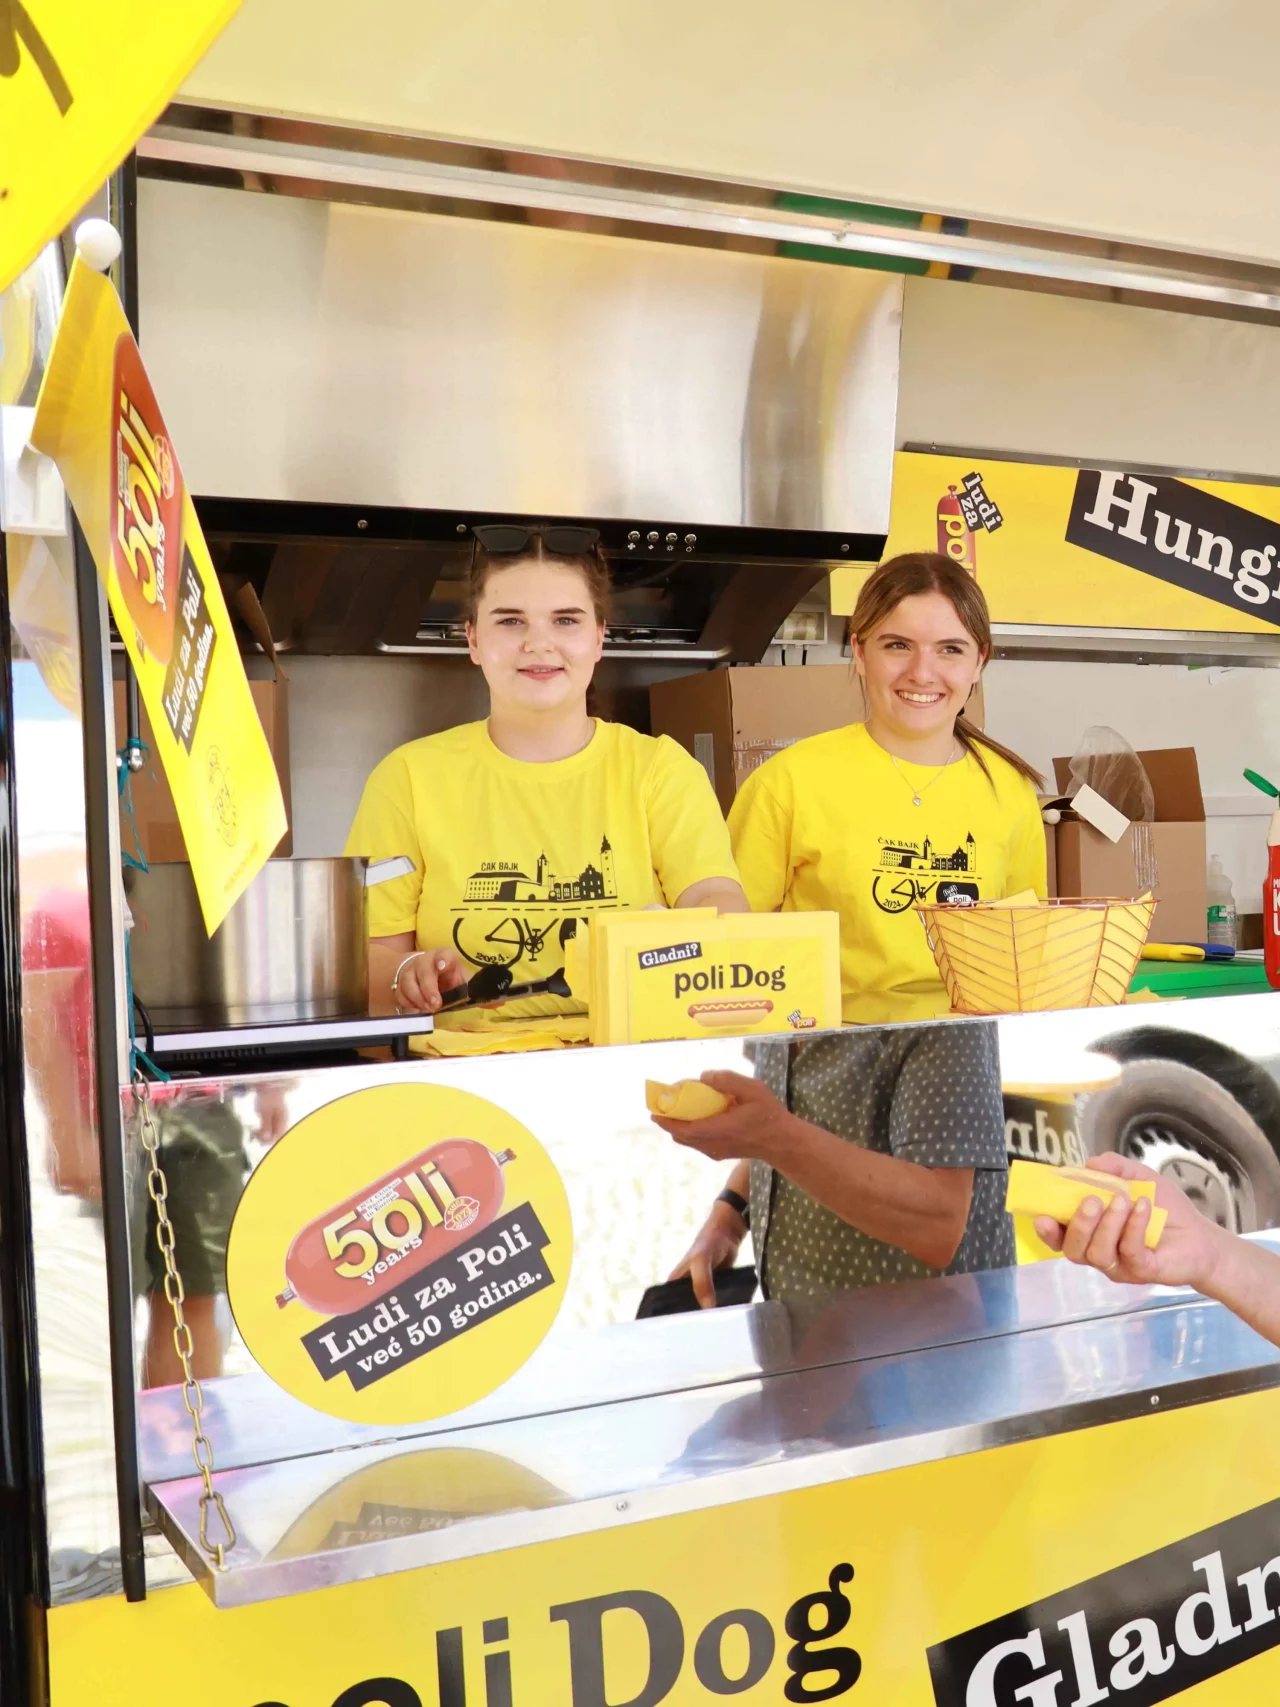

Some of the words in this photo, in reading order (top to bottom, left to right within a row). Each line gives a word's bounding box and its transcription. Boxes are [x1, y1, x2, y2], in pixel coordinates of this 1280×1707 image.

[960, 497, 978, 527] za
[965, 475, 1001, 529] ludi
[938, 514, 974, 577] po
[182, 568, 201, 639] Poli
[180, 634, 192, 672] za
[165, 657, 185, 729] Ludi
[186, 676, 199, 711] 50
[499, 862, 519, 871] BAJK
[898, 841, 919, 849] BAJK
[641, 943, 699, 966] Gladni?
[674, 965, 724, 999] poli
[730, 963, 786, 991] Dog
[361, 1235, 423, 1285] years
[319, 1296, 409, 1364] Ludi
[414, 1274, 457, 1310] za
[457, 1223, 532, 1282] Poli
[357, 1336, 403, 1373] već
[406, 1315, 442, 1347] 50
[449, 1269, 543, 1329] godina.
[549, 1562, 862, 1707] Dog
